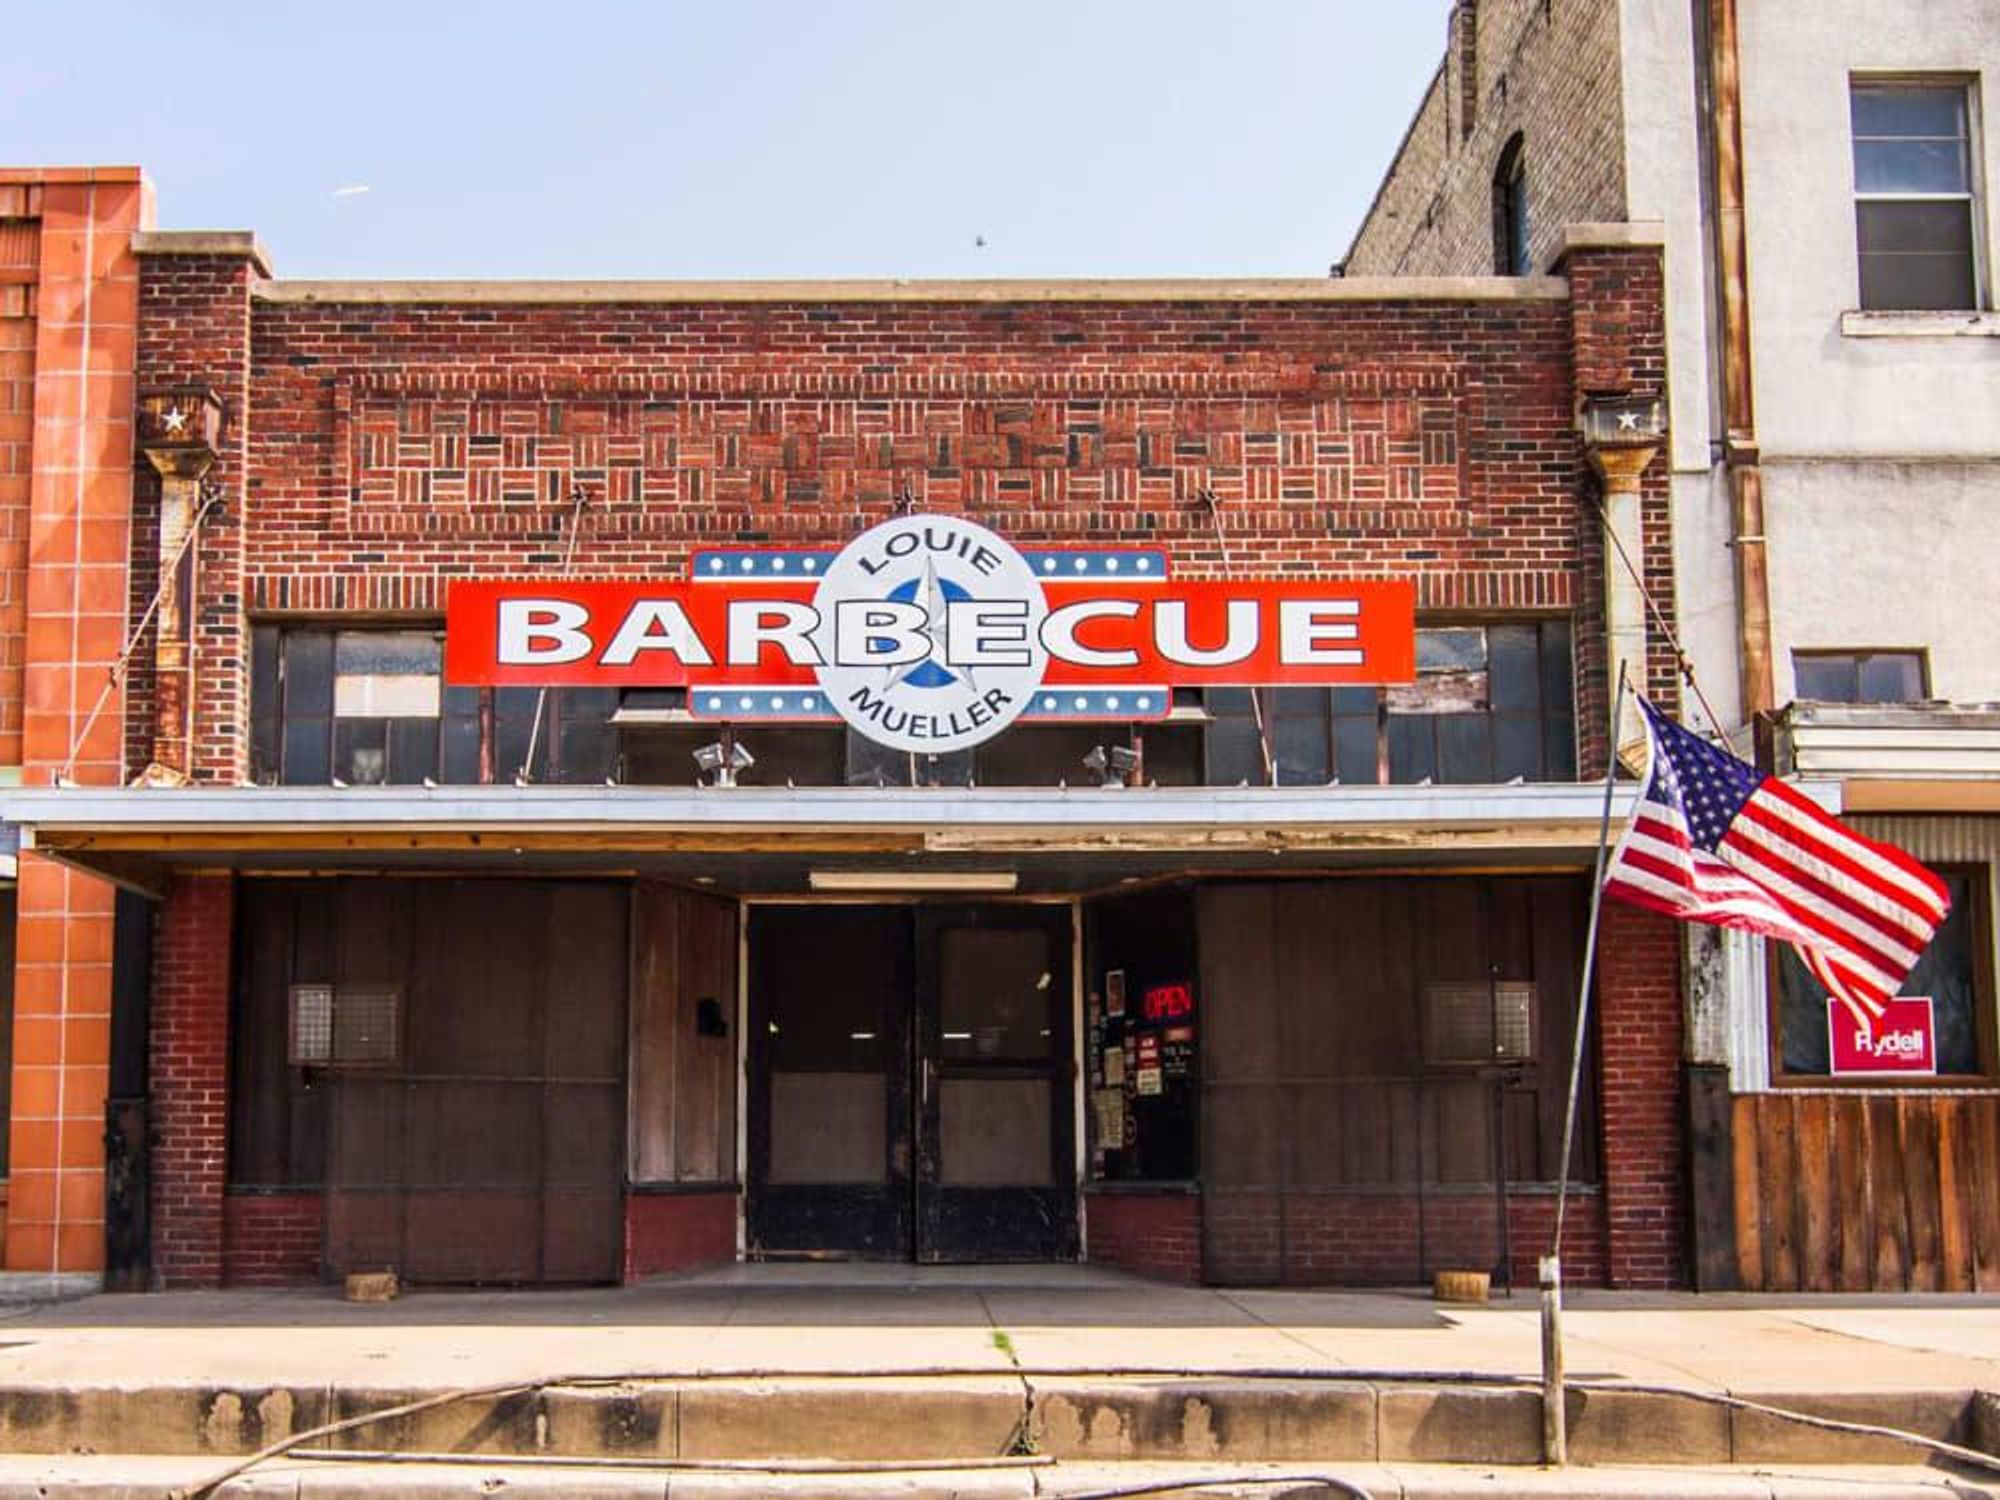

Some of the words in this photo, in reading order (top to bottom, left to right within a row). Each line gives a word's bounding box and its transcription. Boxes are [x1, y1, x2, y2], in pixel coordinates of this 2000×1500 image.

[858, 528, 1002, 576] LOUIE
[496, 598, 1365, 668] BARBECUE
[849, 686, 1012, 738] MUELLER
[1145, 985, 1192, 1018] OPEN
